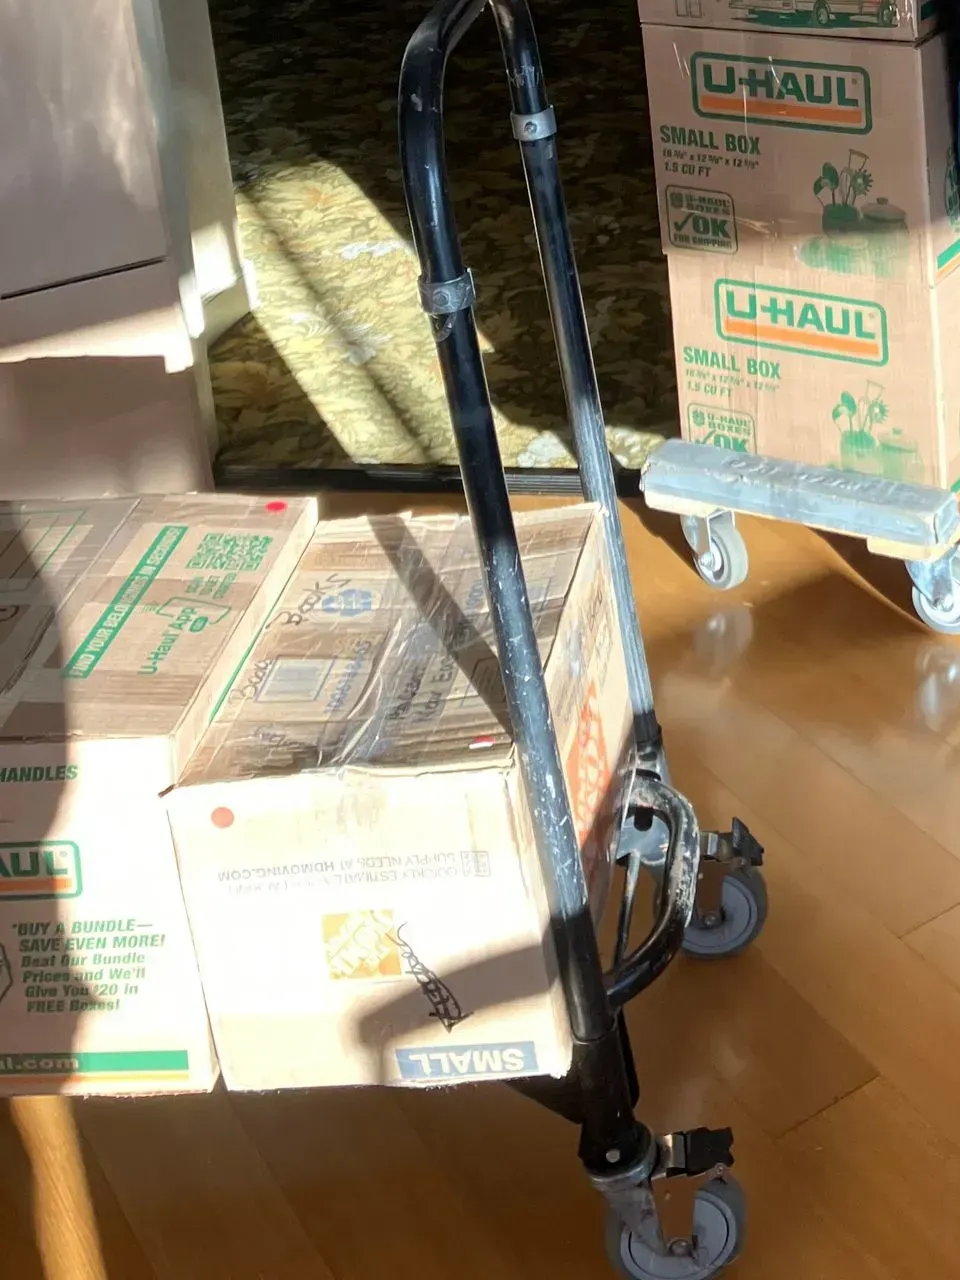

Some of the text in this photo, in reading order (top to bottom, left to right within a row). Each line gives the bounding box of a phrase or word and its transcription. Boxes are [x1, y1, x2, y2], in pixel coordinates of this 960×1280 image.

[702, 63, 860, 107] U-HAUL
[660, 125, 761, 155] SMALL BOX
[681, 164, 695, 175] CU
[698, 166, 711, 177] FT
[692, 214, 731, 239] OK
[725, 289, 876, 340] U-HAUL
[683, 346, 781, 380] SMALL BOX
[704, 384, 717, 395] CU
[720, 387, 732, 398] FT
[138, 607, 197, 675] U-Haul App
[218, 861, 335, 882] HDMOVING.COM
[56, 922, 66, 934] A
[19, 934, 165, 952] SAVE EVEN MORE!
[21, 952, 145, 968] Beat Our Bundle
[23, 971, 70, 983] Prices
[74, 969, 103, 982] and
[25, 985, 58, 997] Give
[63, 984, 89, 997] You
[124, 983, 138, 995] in
[27, 998, 120, 1013] FREE Boxes!
[409, 1052, 526, 1075] SMALL
